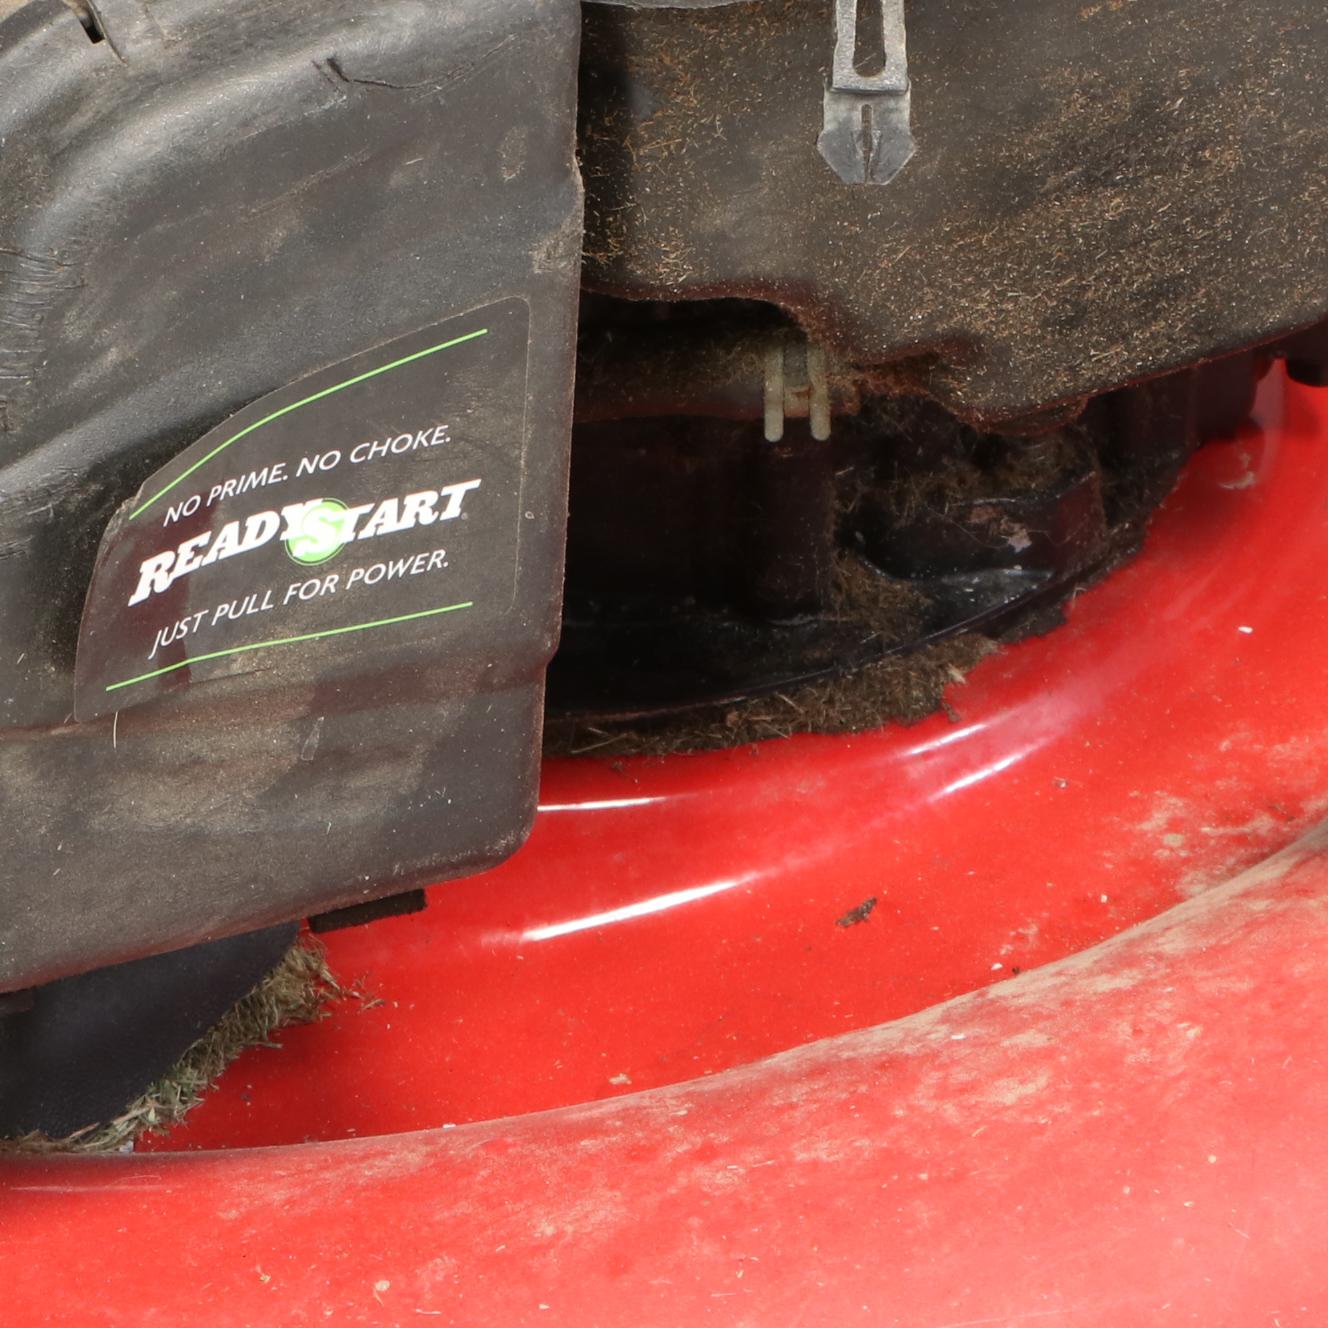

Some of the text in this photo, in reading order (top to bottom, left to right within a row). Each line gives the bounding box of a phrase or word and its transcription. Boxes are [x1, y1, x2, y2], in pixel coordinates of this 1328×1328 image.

[163, 425, 452, 527] NO PRIME. NO CHOKE.
[147, 549, 449, 659] JUST PULL FOR POWER.
